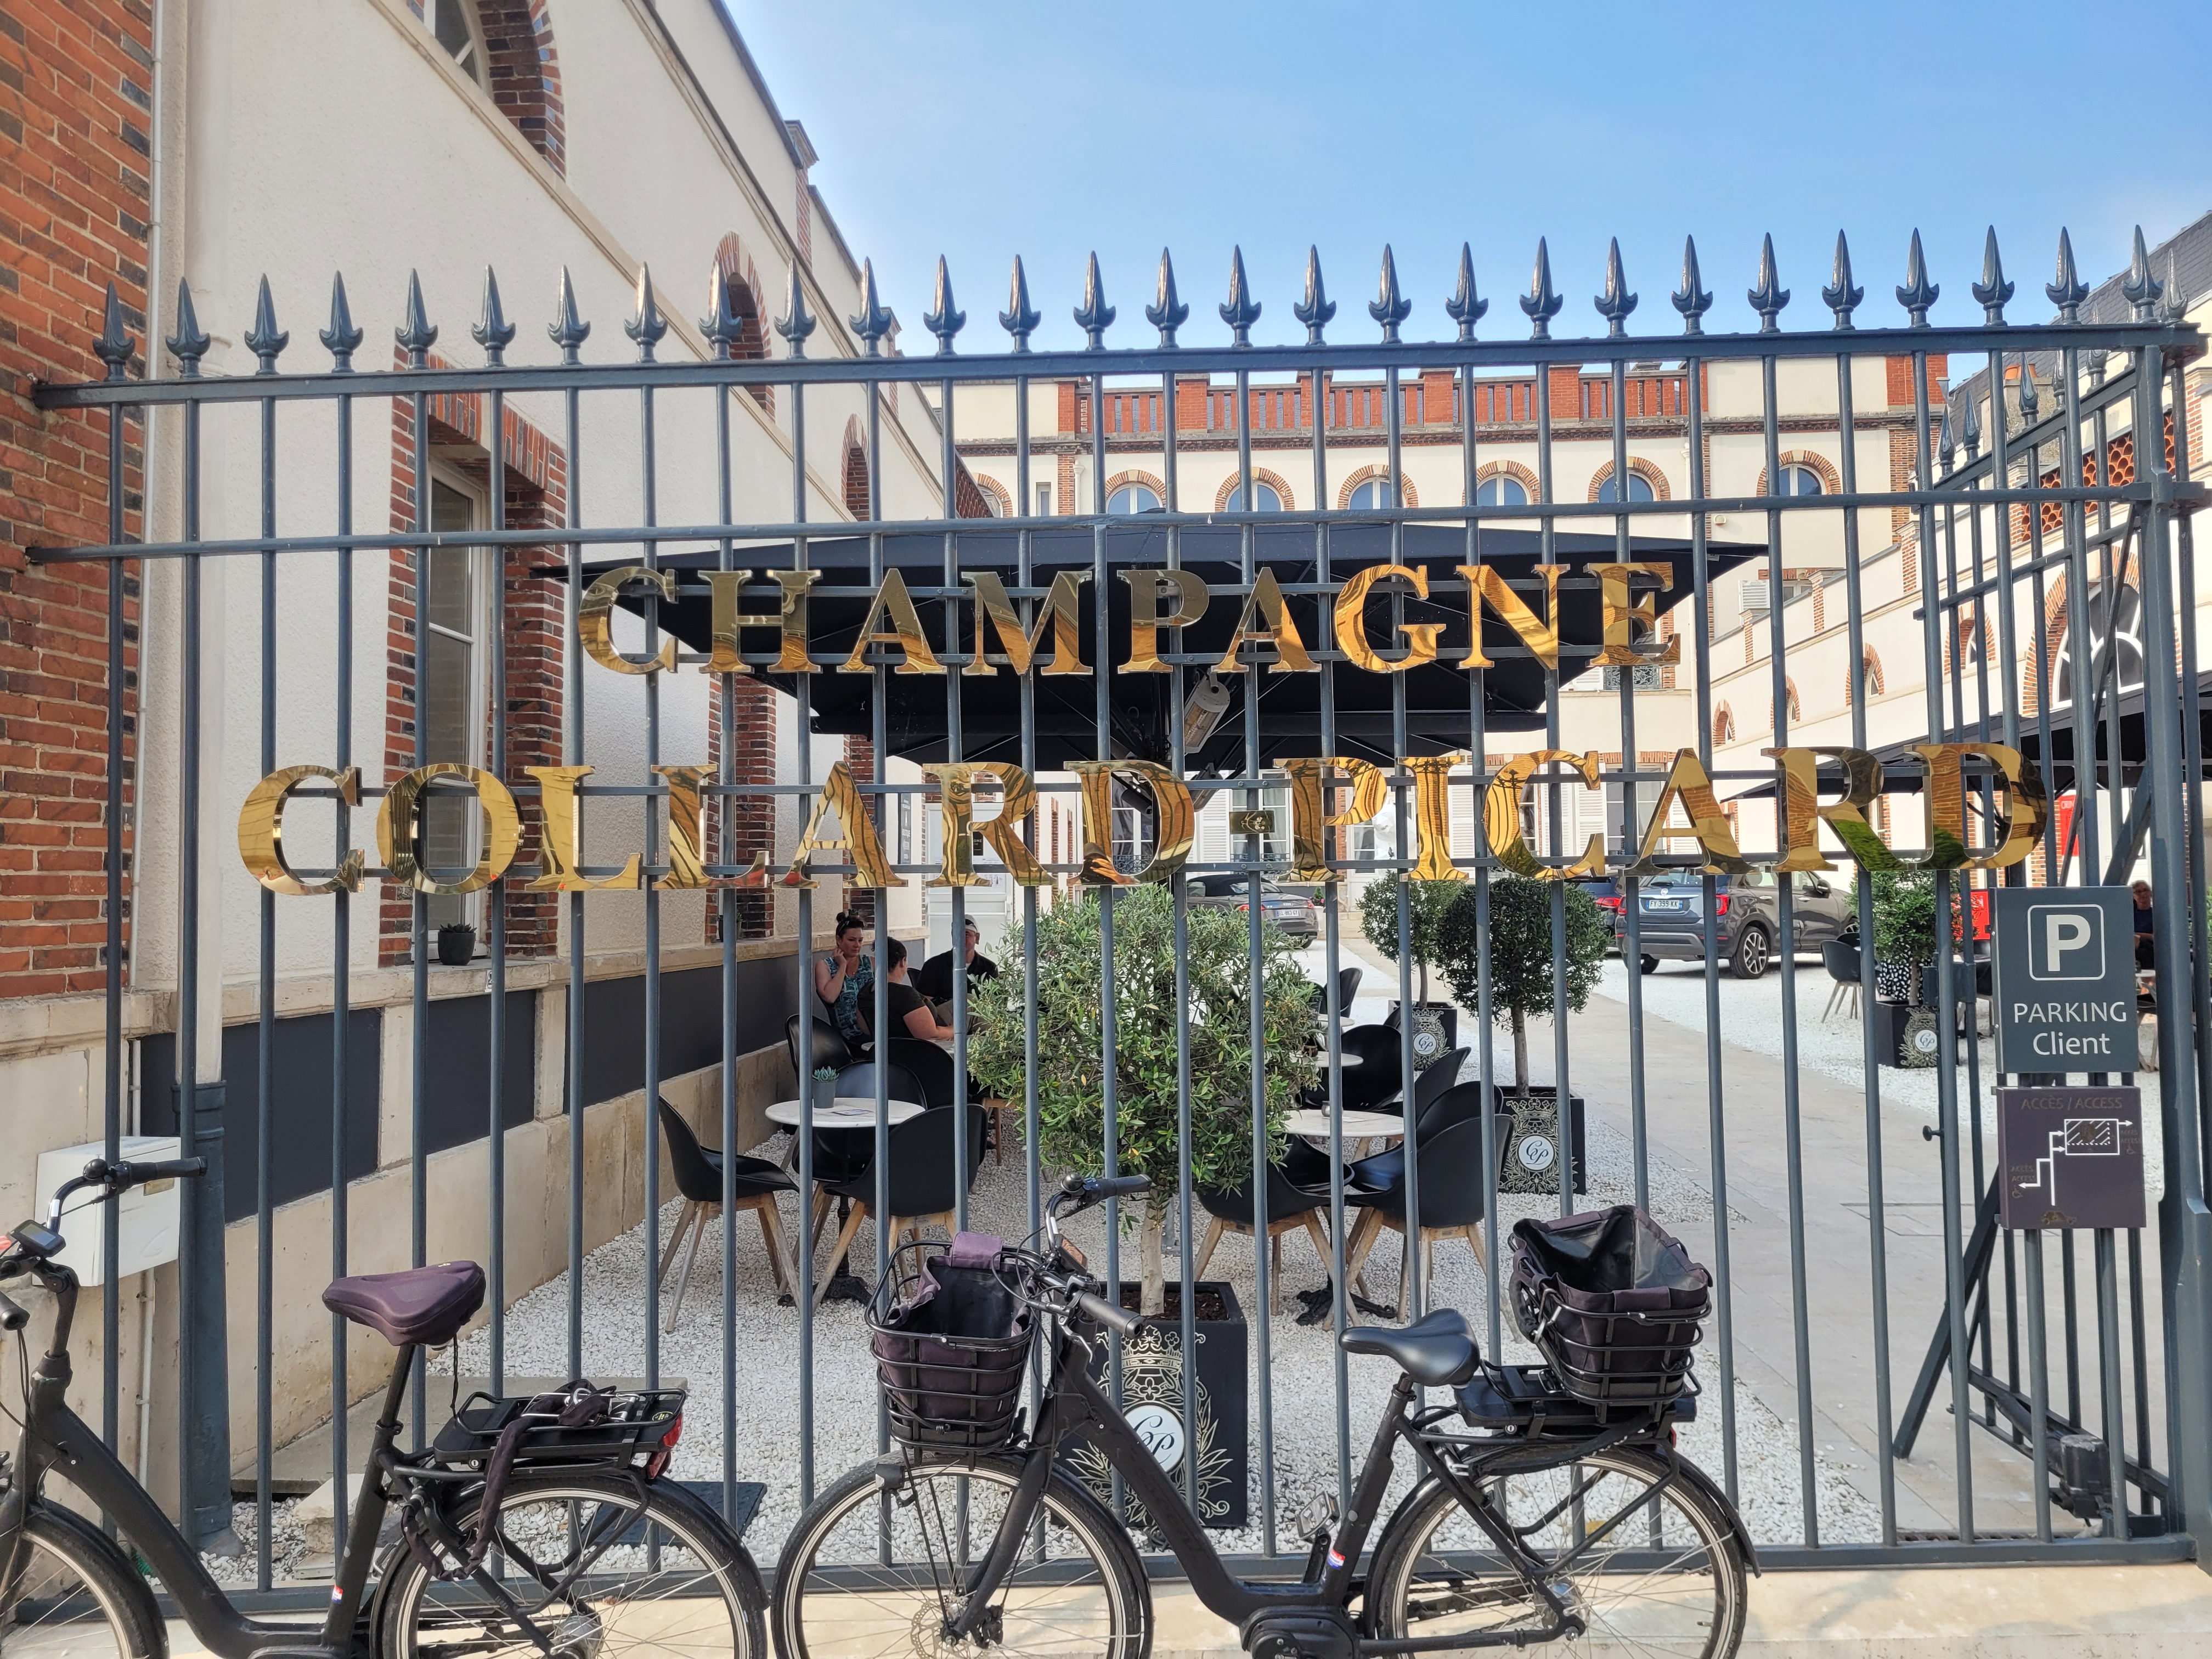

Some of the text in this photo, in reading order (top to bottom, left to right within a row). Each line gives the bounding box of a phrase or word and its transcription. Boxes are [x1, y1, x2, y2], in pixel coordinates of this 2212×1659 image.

[578, 562, 1681, 676] CHAMPAGNE
[2046, 915, 2091, 972] P
[2013, 1001, 2127, 1024] PARKING
[2033, 1032, 2111, 1056] Client
[2021, 1096, 2064, 1110] ACCÈS
[2075, 1097, 2123, 1109] ACCESS
